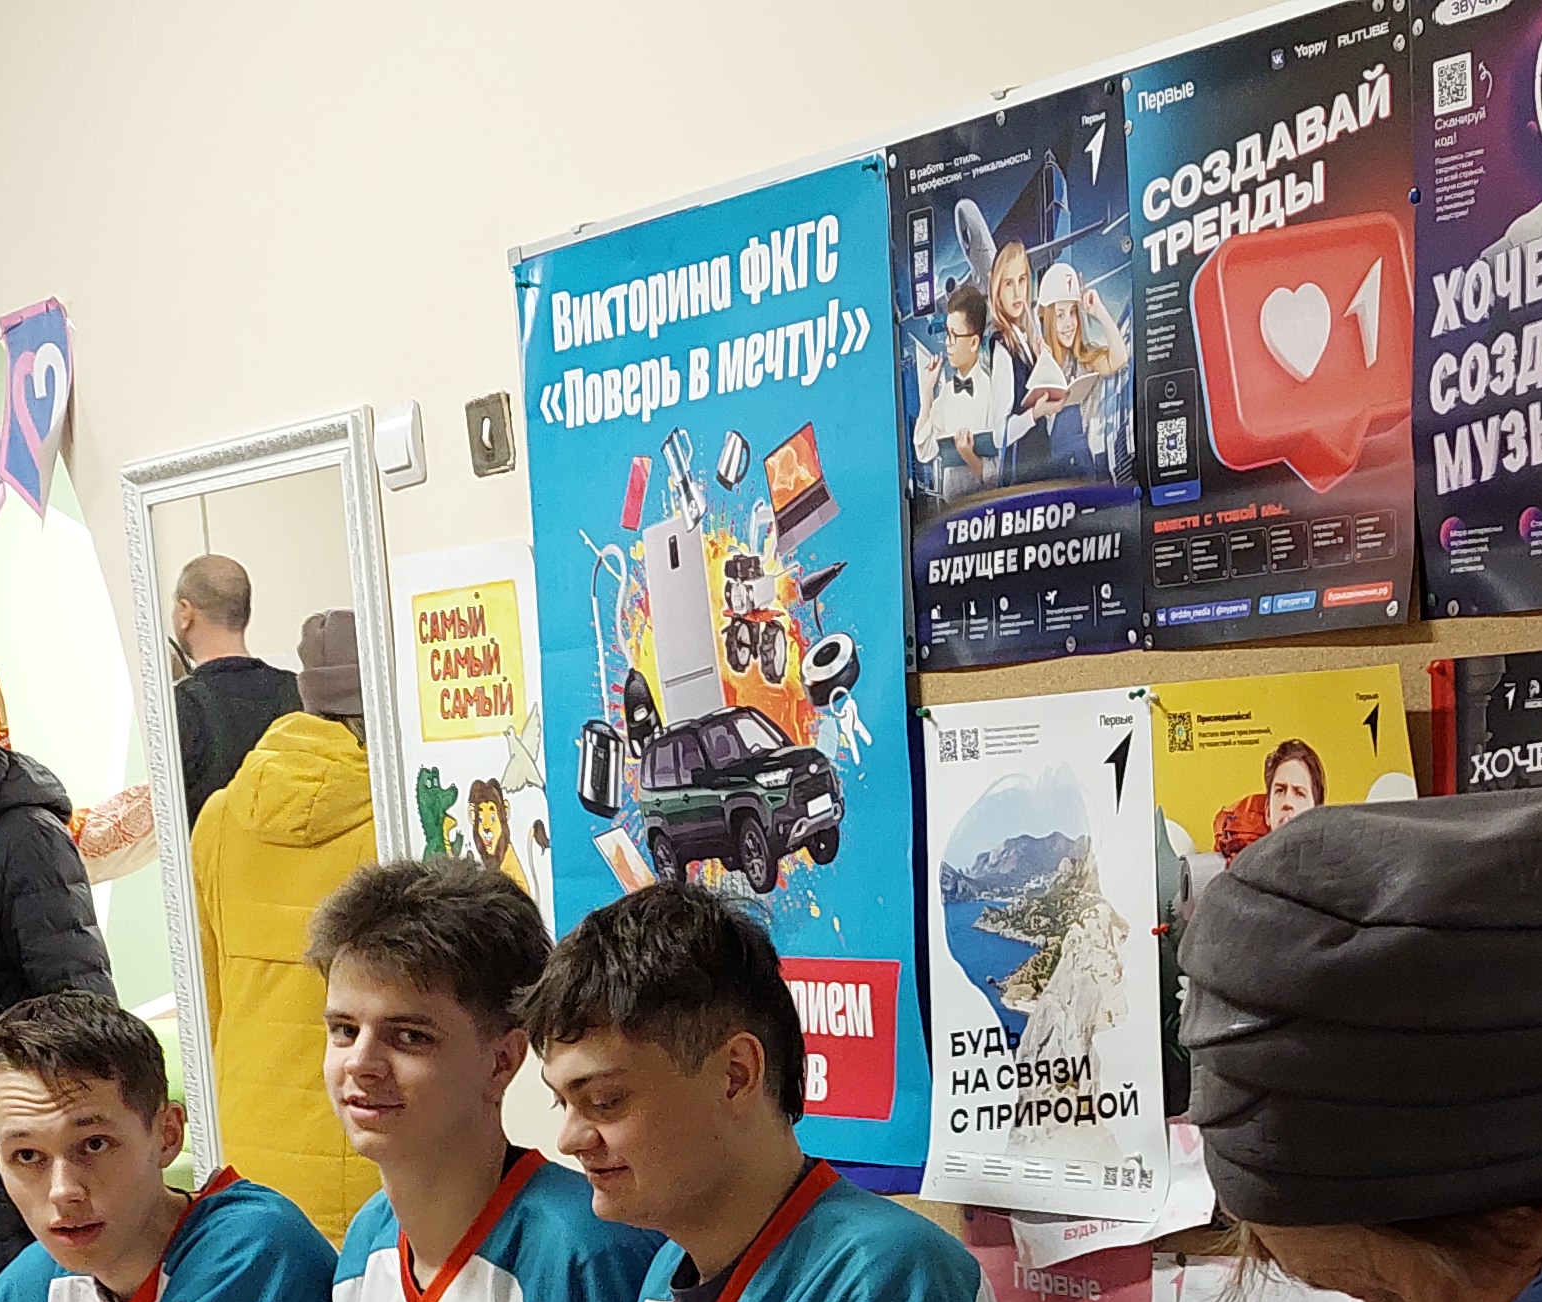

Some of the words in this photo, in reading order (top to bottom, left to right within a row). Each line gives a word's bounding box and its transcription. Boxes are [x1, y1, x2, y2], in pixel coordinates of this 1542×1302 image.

[1337, 21, 1390, 49] RUTUBE
[1138, 82, 1194, 113] Первые
[1434, 106, 1487, 131] Сканируй
[1142, 63, 1393, 222] СОЗДАВАЙ
[1434, 130, 1458, 149] код!
[972, 149, 1032, 178] уникальность!
[1142, 161, 1325, 274] ТРЕНДЫ
[551, 254, 734, 353] Викторина
[739, 214, 840, 305] ФКГС
[539, 355, 682, 429] «Поверь
[716, 298, 872, 395] мечту!»
[946, 508, 995, 545] ТВОЙ
[1001, 501, 1076, 537] ВЫБОР
[1216, 504, 1257, 524] ТОБОЙ
[928, 548, 1019, 587] БУДУЩЕЕ
[1023, 532, 1122, 571] РОССИИ!
[418, 591, 487, 645] САМЫЙ
[430, 637, 501, 682] САМЫЙ
[440, 676, 514, 720] САМЫЙ
[1099, 714, 1134, 728] Первые
[949, 1025, 1021, 1059] БУДЬ
[951, 1068, 991, 1096] НА
[996, 1054, 1092, 1091] СВЯЗИ
[950, 1108, 969, 1134] С
[976, 1082, 1139, 1132] ПРИРОДОЙ
[1013, 1261, 1102, 1302] Первые
